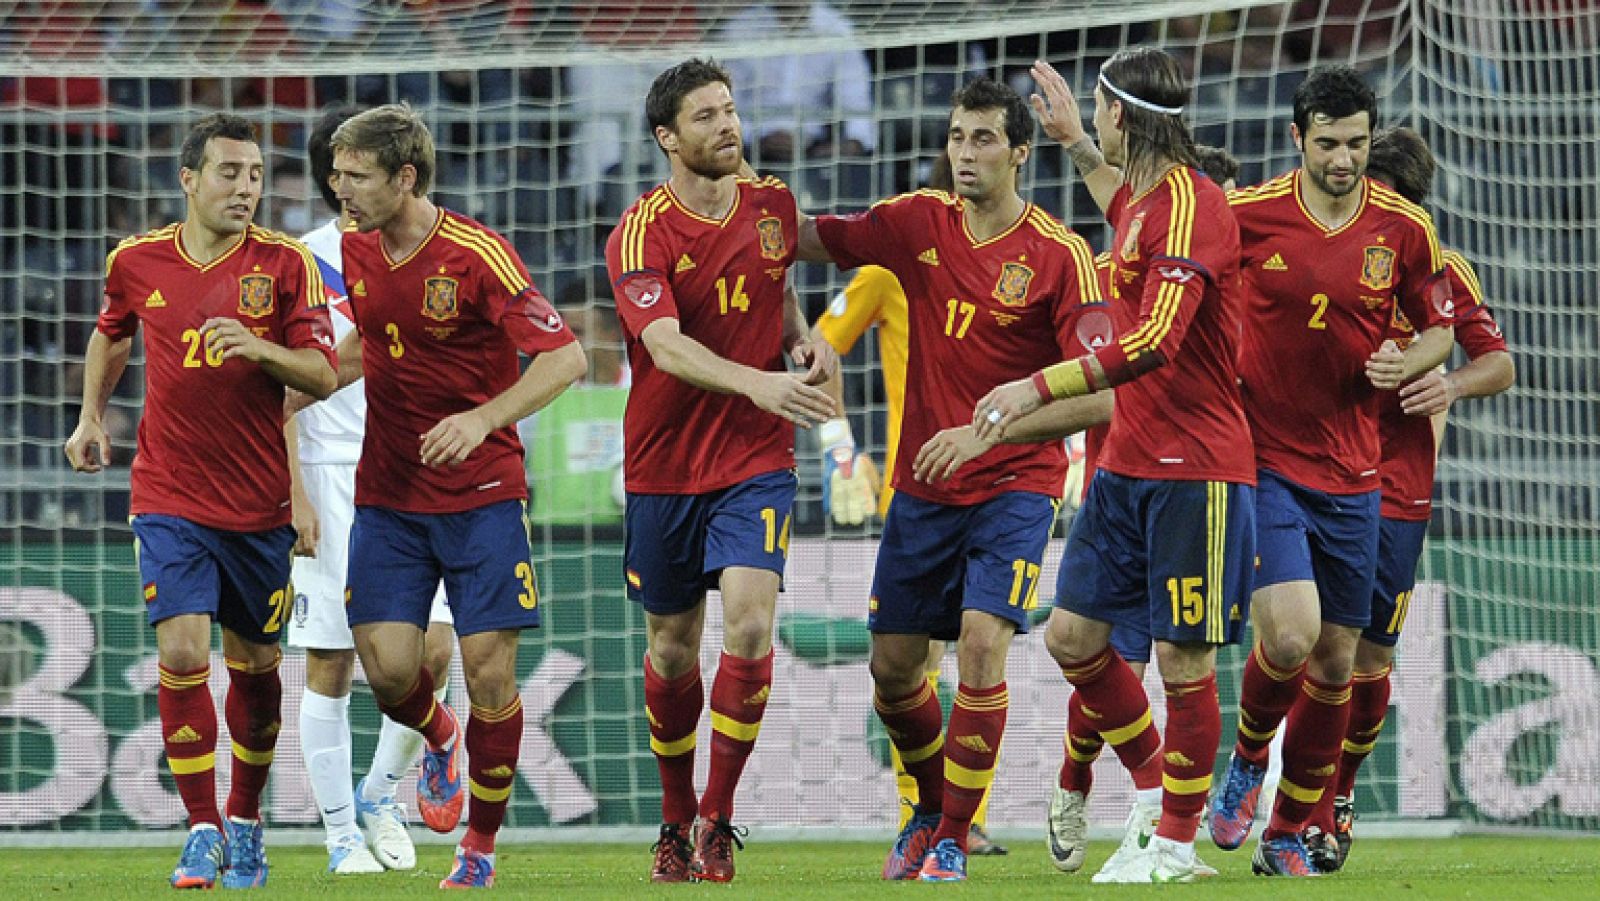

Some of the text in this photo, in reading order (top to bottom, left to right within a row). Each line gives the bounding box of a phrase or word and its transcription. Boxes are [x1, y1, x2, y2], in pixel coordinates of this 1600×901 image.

[715, 274, 750, 315] 14
[1308, 293, 1329, 330] 2
[945, 298, 976, 338] 17
[384, 323, 404, 358] 3
[514, 562, 537, 609] 3
[1007, 559, 1041, 610] 17
[1166, 576, 1204, 627] 15
